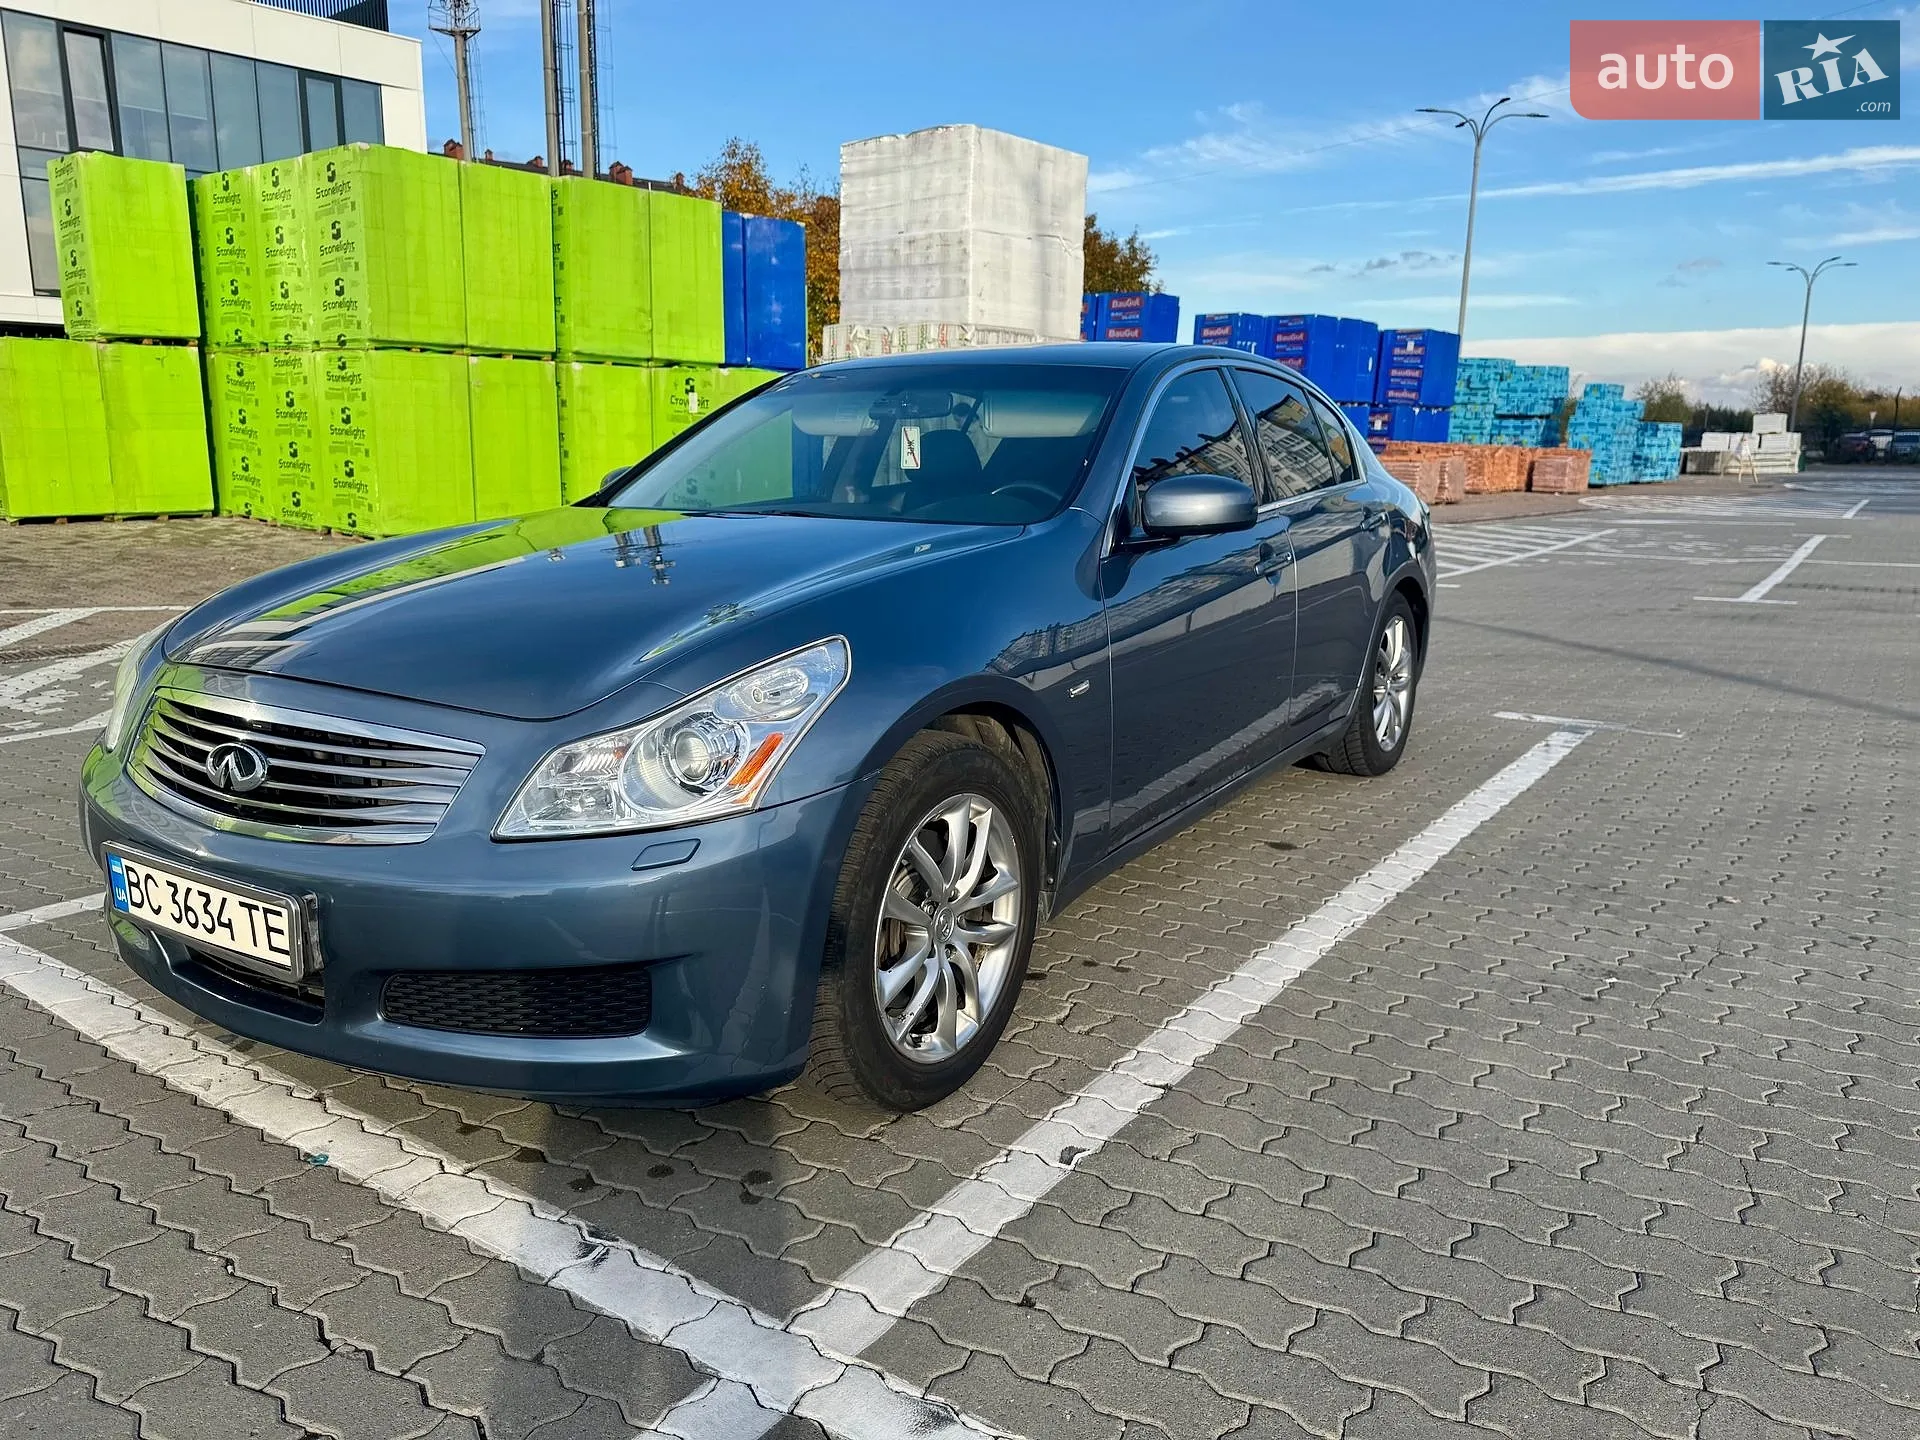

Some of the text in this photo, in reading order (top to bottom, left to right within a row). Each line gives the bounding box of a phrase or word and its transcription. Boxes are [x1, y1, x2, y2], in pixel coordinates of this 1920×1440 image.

[262, 187, 292, 202] Stonelight
[316, 181, 351, 199] Stonelight
[213, 192, 241, 205] Stonelight
[216, 246, 246, 259] Stonelight
[265, 244, 297, 259] Stonelight
[320, 240, 355, 257] Stonelight
[221, 297, 251, 311] Stonelight
[270, 300, 303, 314] Stonelight
[322, 298, 358, 311] Stonelight
[1111, 297, 1140, 309] BauGut
[1108, 328, 1139, 338] BauGut
[226, 375, 256, 391] Stonelight
[326, 371, 362, 385] Stonelight
[275, 408, 308, 422] Stonelight
[229, 422, 259, 440] Stonelight
[330, 424, 366, 440] Stonelight
[278, 458, 311, 473] Stonelight
[231, 471, 261, 488] Stonelight
[333, 477, 369, 494] Stonelight
[281, 507, 313, 522] Stonelight
[116, 888, 127, 902] UA
[124, 865, 290, 955] BC 3634 TE
